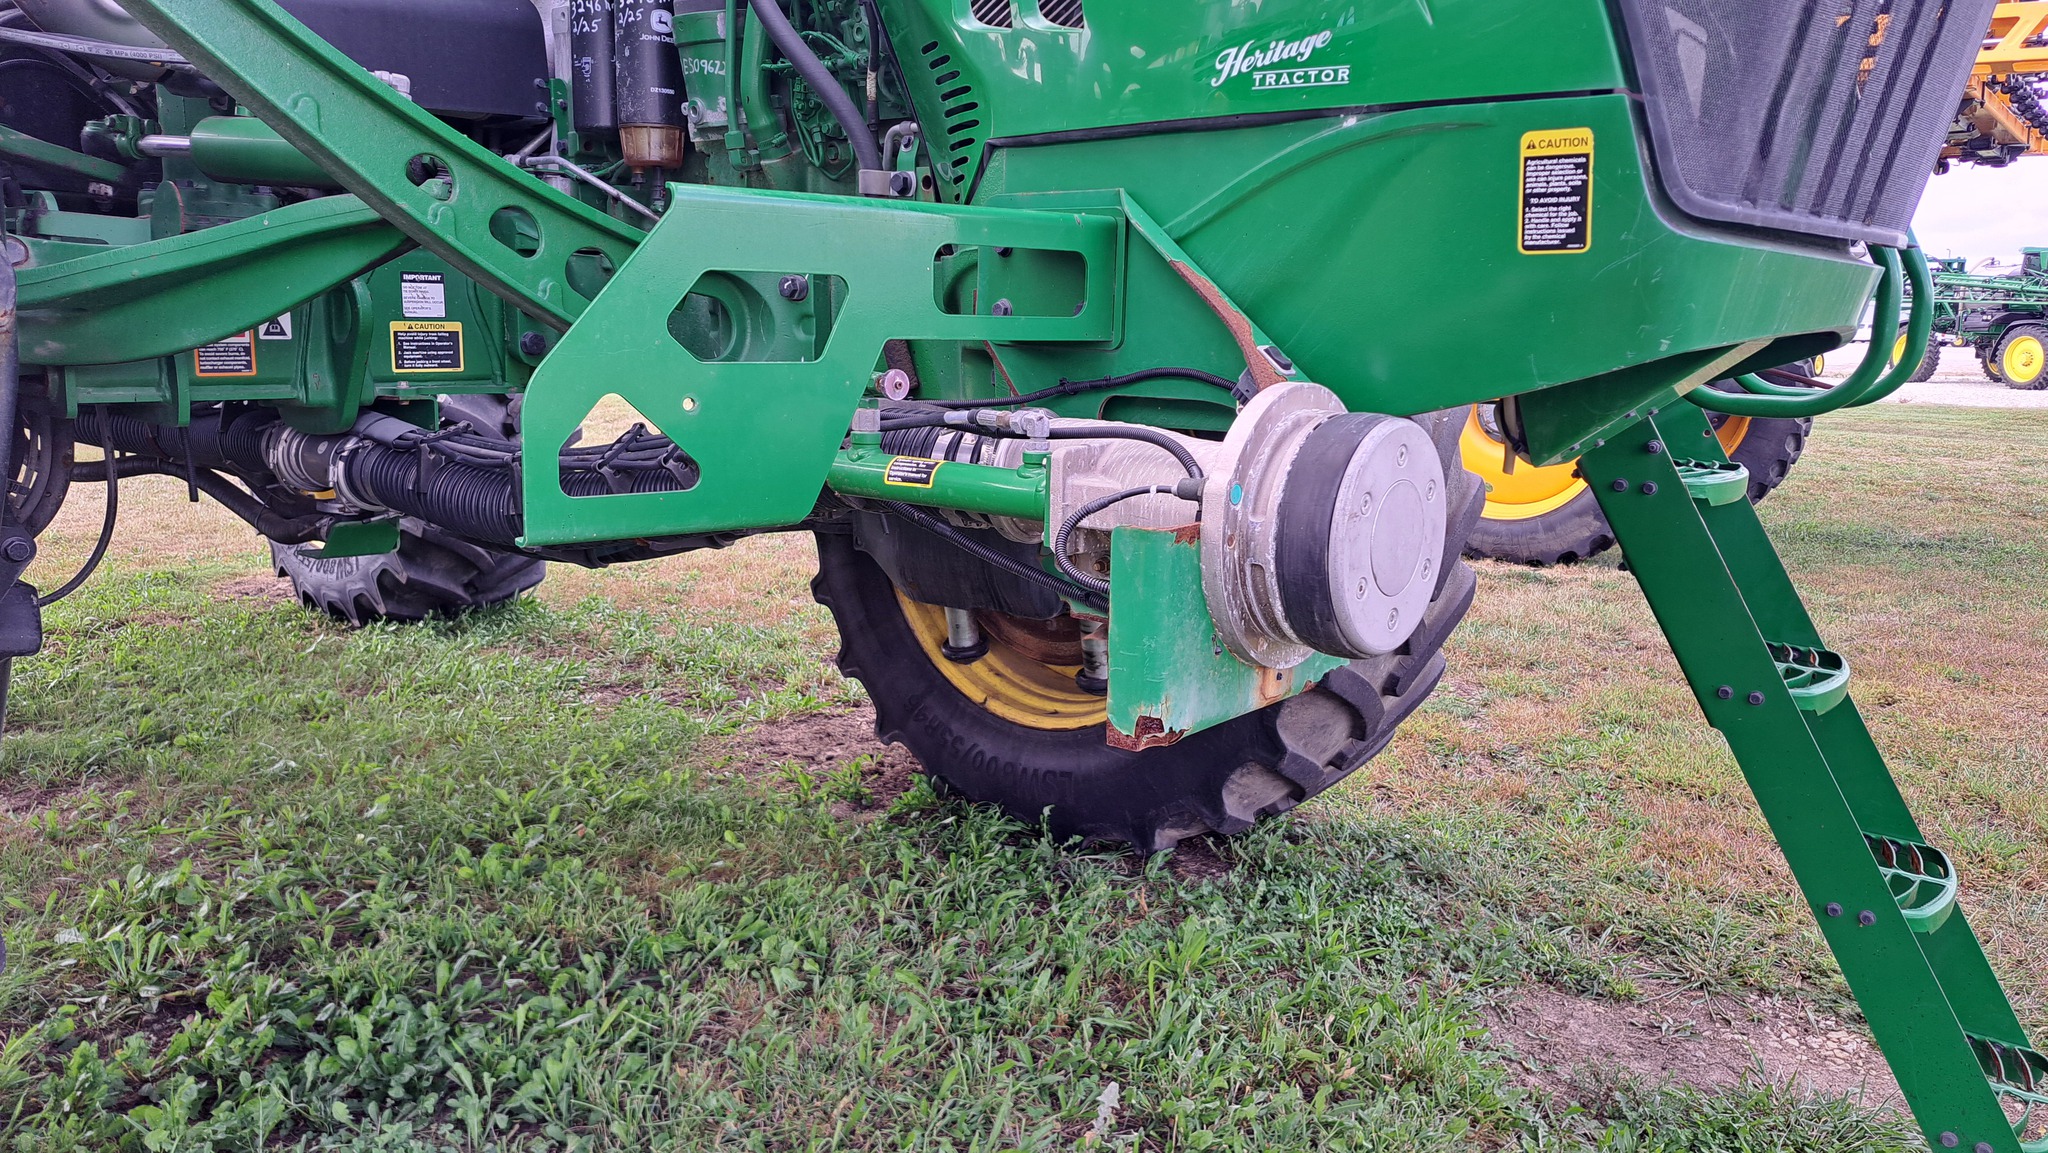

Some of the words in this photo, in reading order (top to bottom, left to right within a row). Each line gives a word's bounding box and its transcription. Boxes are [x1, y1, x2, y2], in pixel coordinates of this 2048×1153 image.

[619, 7, 644, 27] 2/25
[572, 16, 602, 36] 2/25
[639, 33, 661, 42] JOHN
[1210, 29, 1333, 88] Heritage
[1252, 67, 1351, 88] TRACTOR
[1538, 136, 1589, 150] CAUTION
[1539, 196, 1559, 204] AVOID
[1558, 195, 1582, 203] INJURY
[402, 273, 442, 282] IMPORTANT
